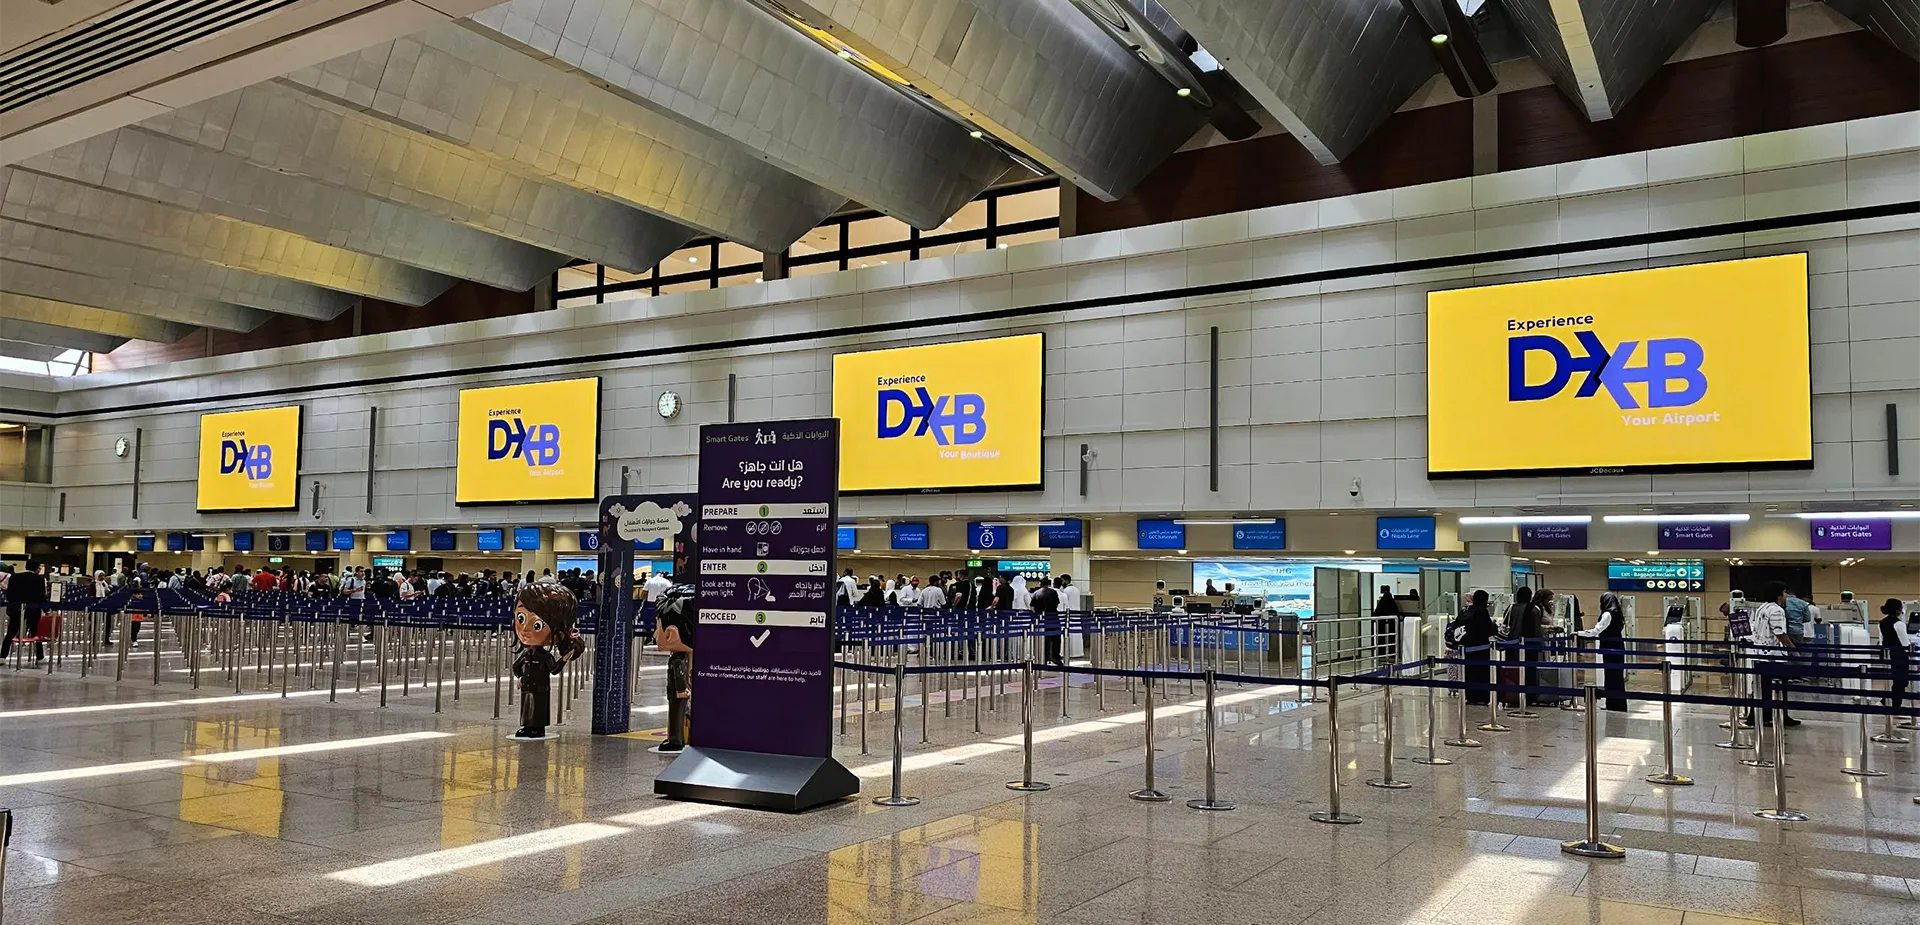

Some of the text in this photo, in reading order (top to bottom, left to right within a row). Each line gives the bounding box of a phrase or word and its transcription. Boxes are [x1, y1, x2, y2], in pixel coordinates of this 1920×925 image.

[1507, 314, 1594, 332] Experience
[1508, 330, 1708, 410] DXB
[877, 374, 926, 387] Experience
[489, 408, 521, 417] Experience
[877, 387, 987, 446] DXB
[1621, 410, 1720, 426] Your Airport
[706, 434, 749, 444] Smart Gates
[782, 430, 829, 440] البوابات الذكية
[488, 418, 560, 466] DXB
[939, 450, 958, 458] Your
[220, 439, 273, 480] DXB
[738, 461, 767, 475] جاهز؟
[788, 460, 804, 472] هل
[722, 475, 804, 491] Are you ready?
[704, 507, 738, 516] PREPARE
[761, 507, 766, 515] 1
[802, 506, 827, 515] استعد
[703, 524, 728, 532] Remove
[719, 545, 726, 553] in
[726, 545, 742, 553] hand
[702, 563, 727, 571] ENTER
[759, 563, 765, 572] 2
[808, 563, 826, 572] ادخل
[701, 580, 716, 588] Look
[700, 589, 734, 598] green light
[1221, 598, 1235, 608] 40
[700, 612, 737, 621] PROCEED
[757, 614, 764, 623] 3
[809, 614, 825, 626] تابع
